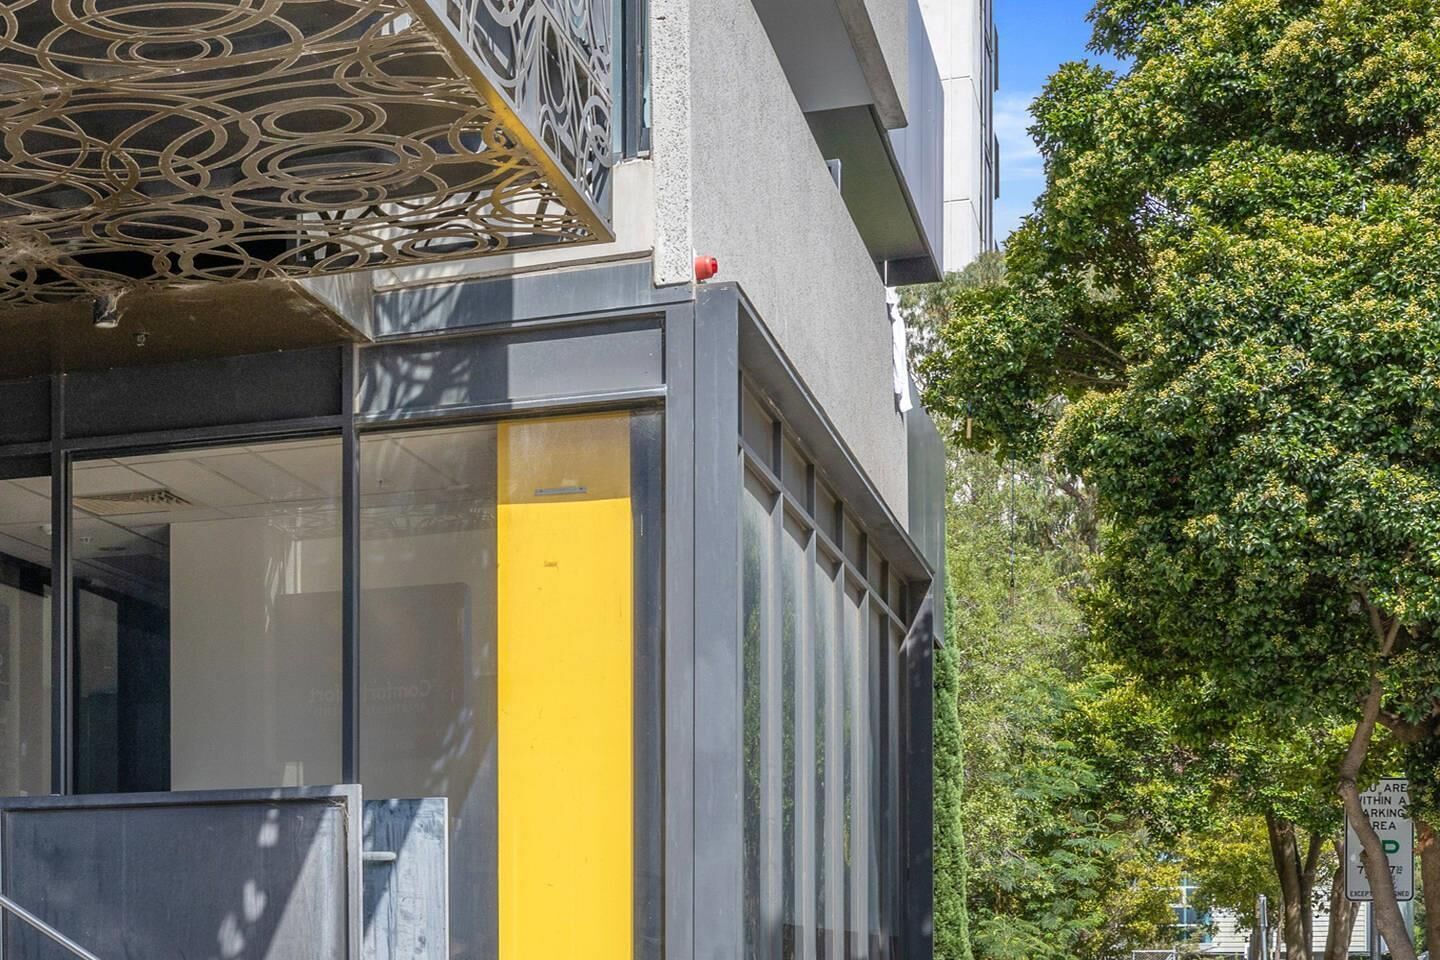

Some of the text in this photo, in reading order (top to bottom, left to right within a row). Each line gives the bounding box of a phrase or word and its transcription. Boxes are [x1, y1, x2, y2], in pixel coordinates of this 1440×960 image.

[1383, 783, 1407, 792] ARE
[1359, 796, 1407, 805] ITHIN A
[1363, 808, 1404, 818] ARKING
[1372, 821, 1397, 830] REA
